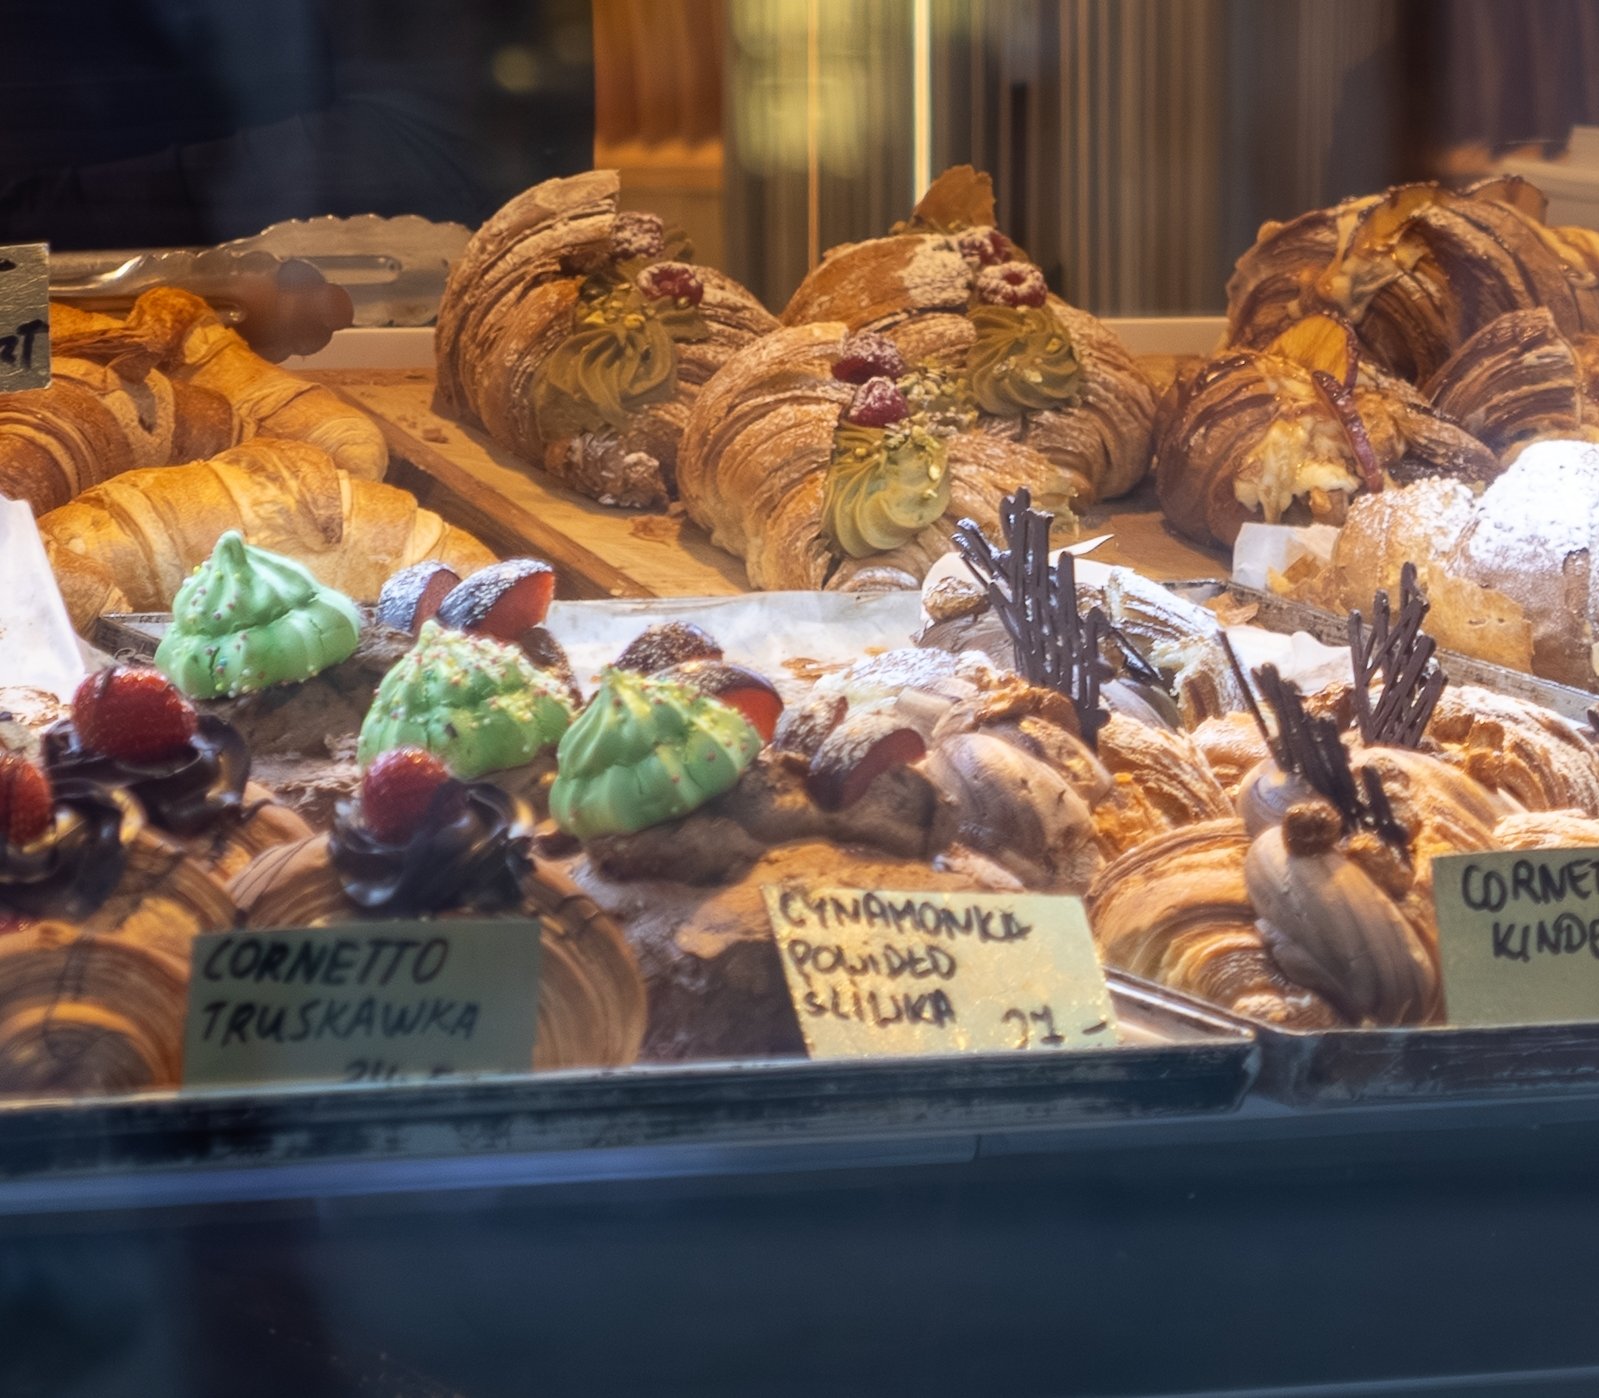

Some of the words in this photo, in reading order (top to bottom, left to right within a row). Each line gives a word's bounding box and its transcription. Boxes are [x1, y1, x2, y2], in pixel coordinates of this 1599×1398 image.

[779, 888, 1033, 943] CYNAMONKA
[202, 936, 450, 987] CORNETTO
[202, 994, 481, 1047] TRUSKAWKA
